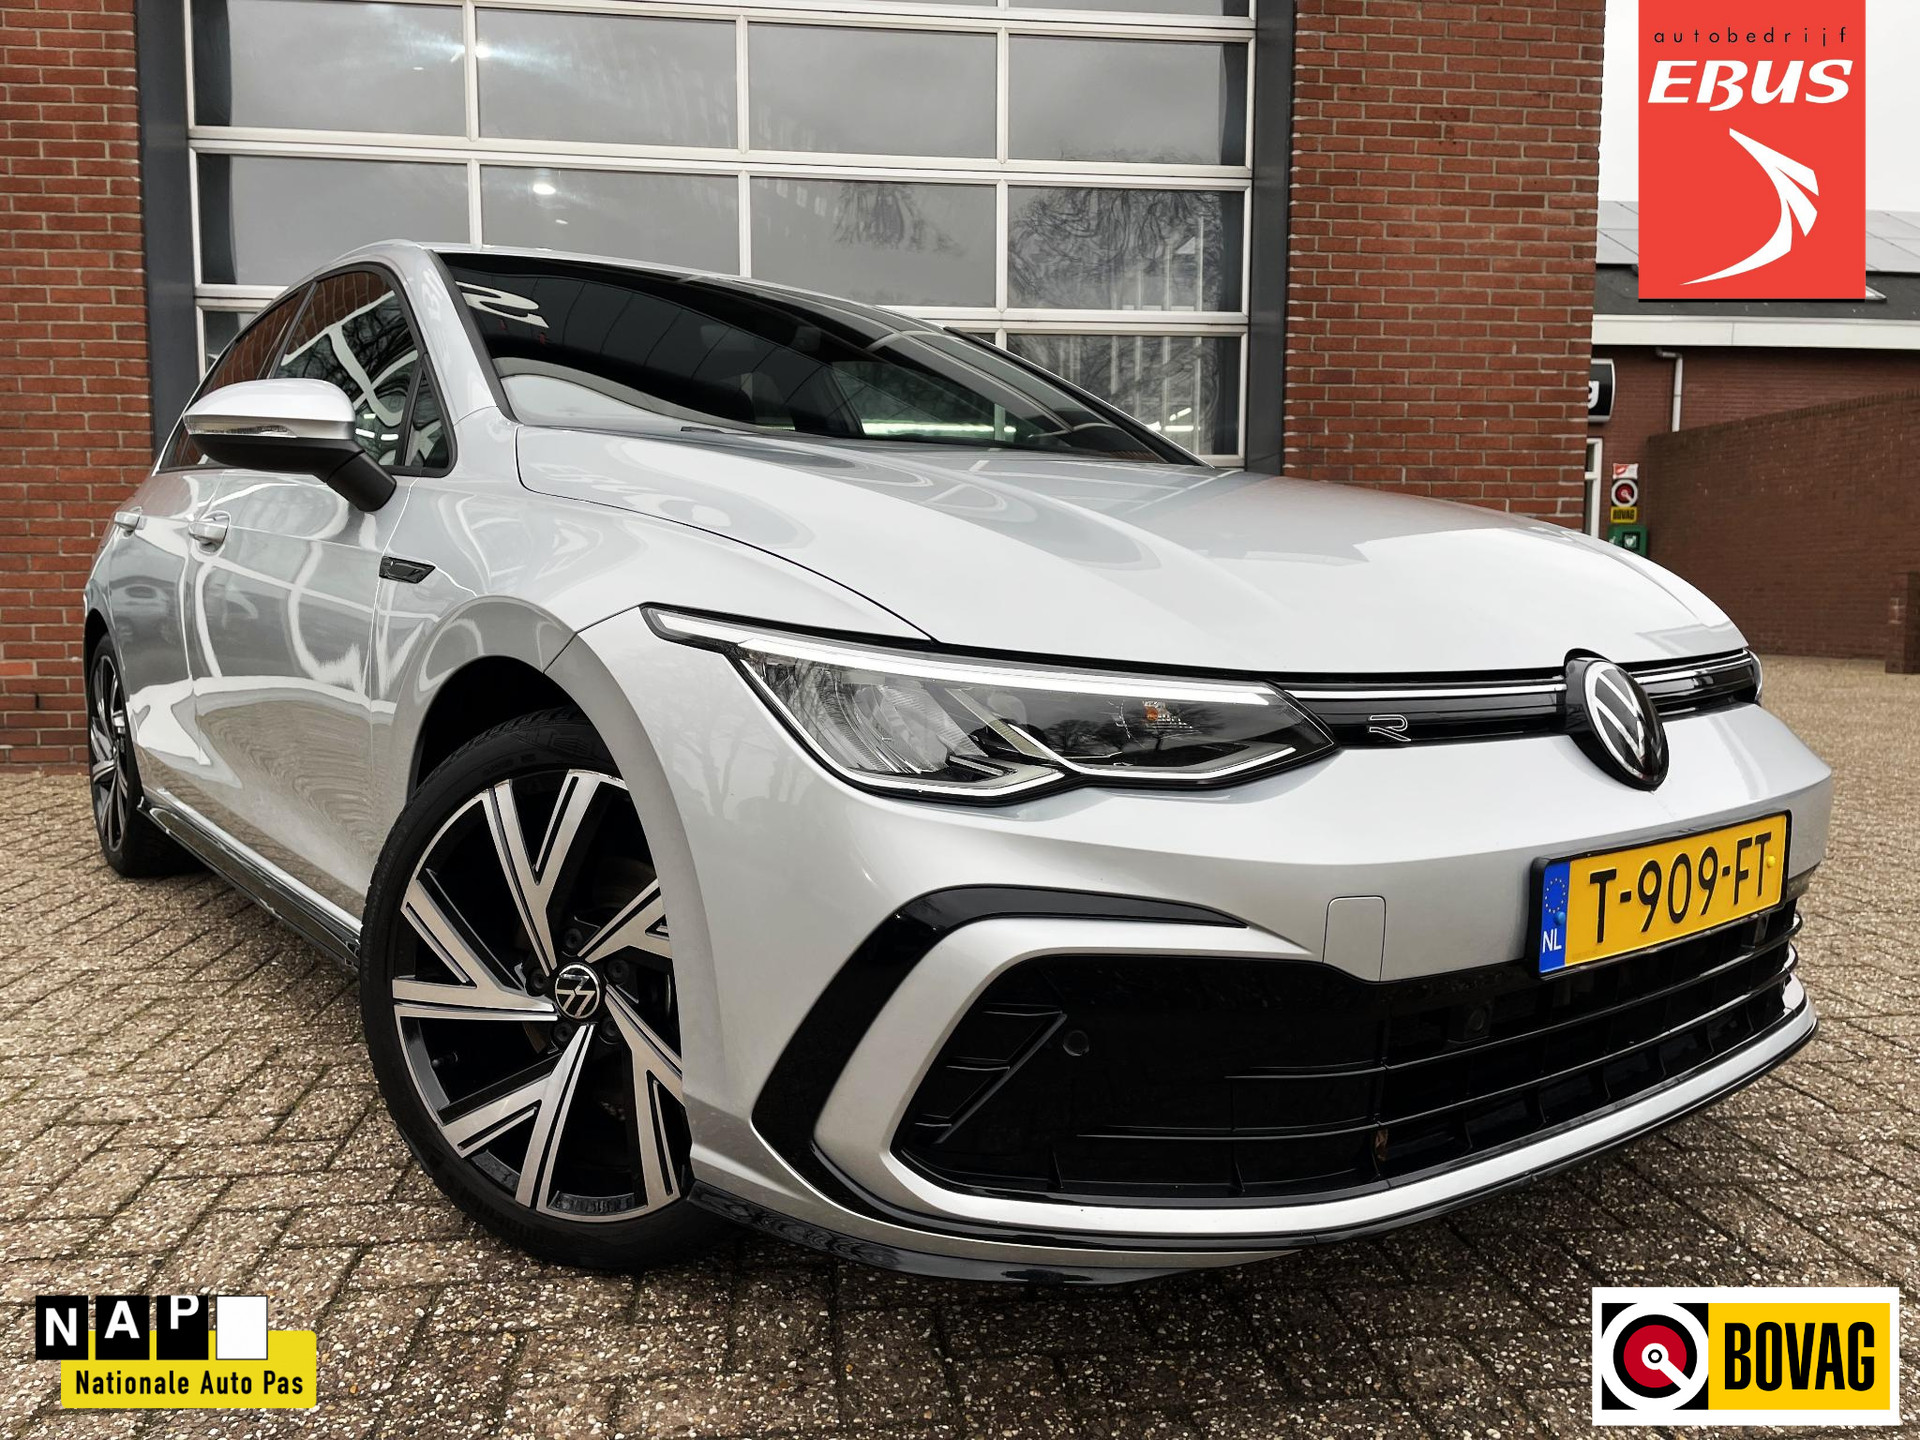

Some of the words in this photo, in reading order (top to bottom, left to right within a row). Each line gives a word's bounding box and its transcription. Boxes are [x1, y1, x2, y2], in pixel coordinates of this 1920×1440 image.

[1368, 714, 1412, 743] R
[1542, 929, 1562, 954] NL
[1589, 831, 1772, 944] T-909-FT
